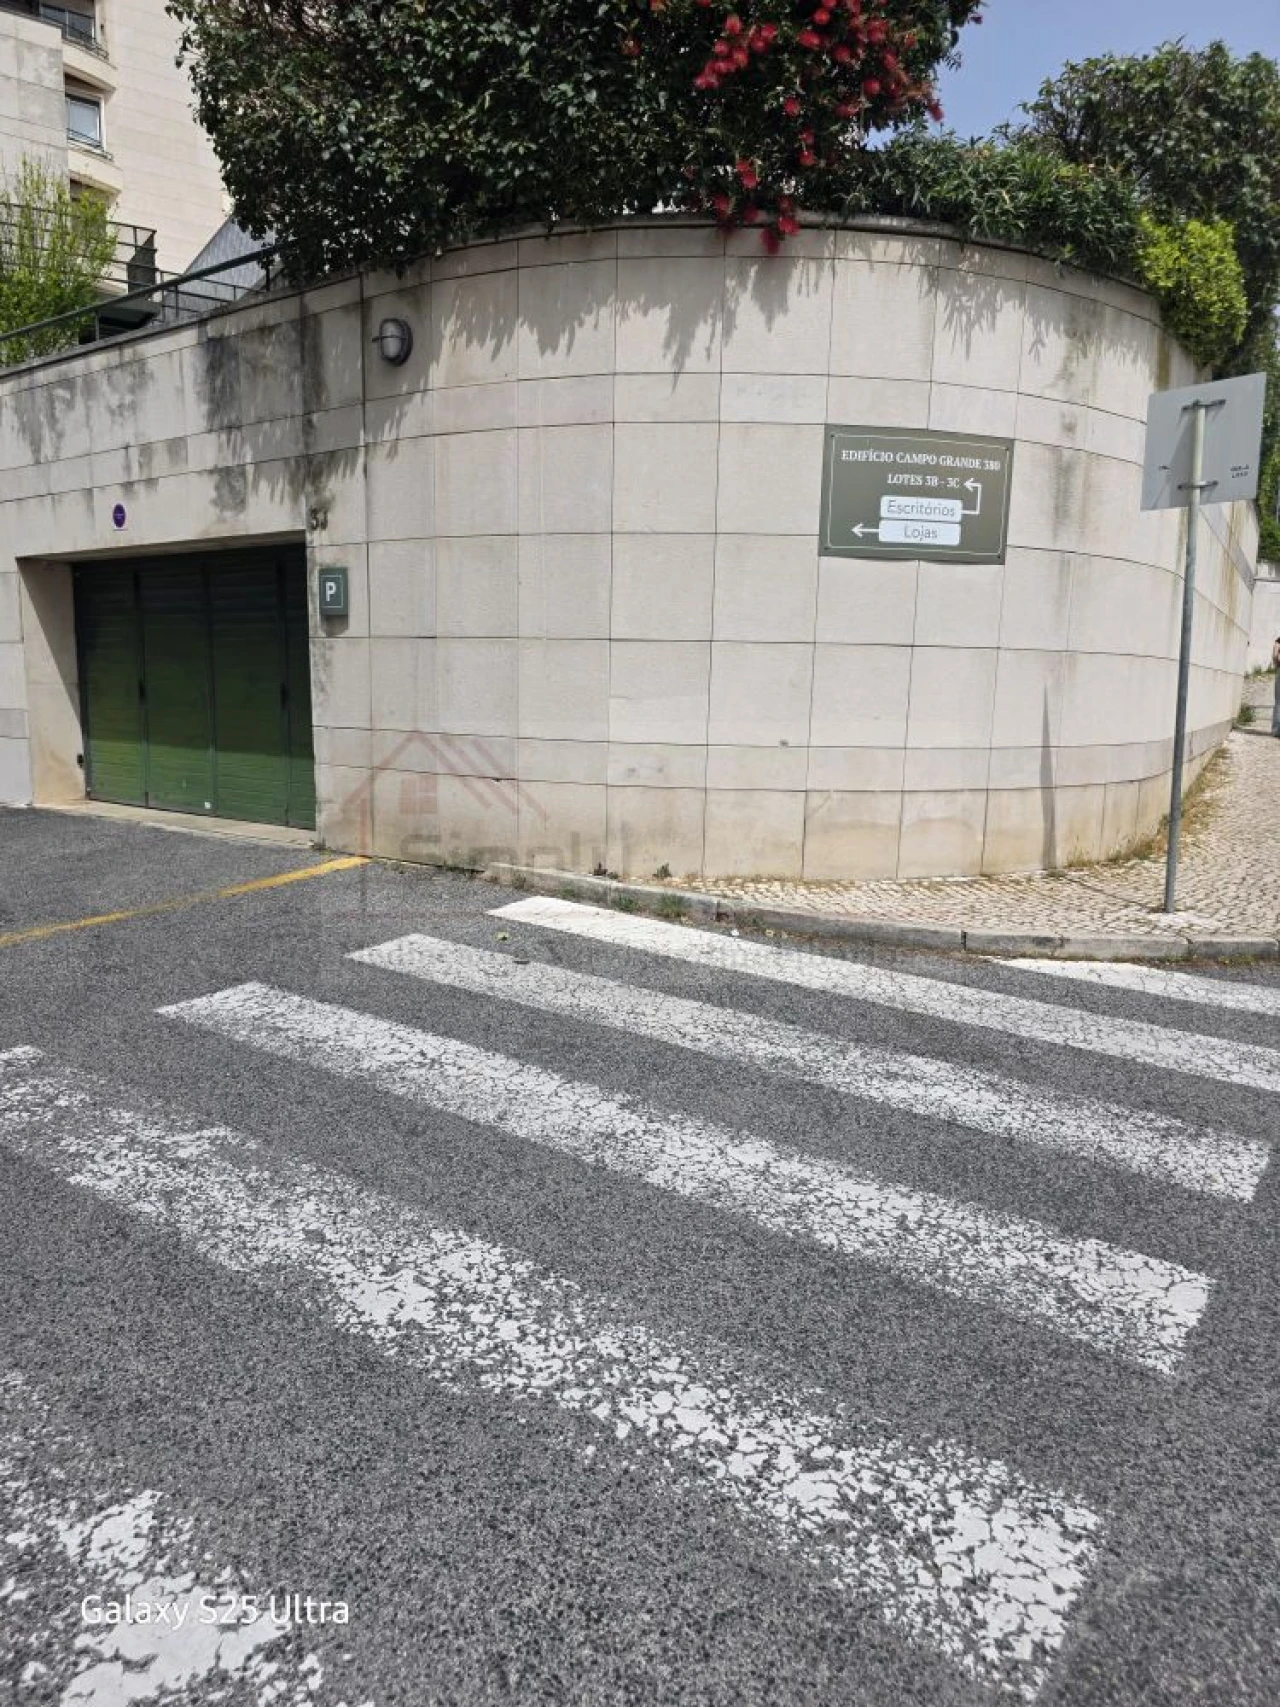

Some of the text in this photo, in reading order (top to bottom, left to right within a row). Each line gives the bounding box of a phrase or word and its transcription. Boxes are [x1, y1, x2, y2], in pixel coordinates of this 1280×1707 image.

[841, 449, 894, 463] EDIFÍCIO
[895, 451, 938, 465] CAMPO
[939, 455, 982, 469] GRANDE
[887, 473, 923, 486] LOTES
[924, 475, 939, 487] 3B
[946, 477, 960, 489] 3C
[887, 499, 956, 518] Escritórios
[904, 525, 939, 542] Lojas
[325, 582, 337, 602] P
